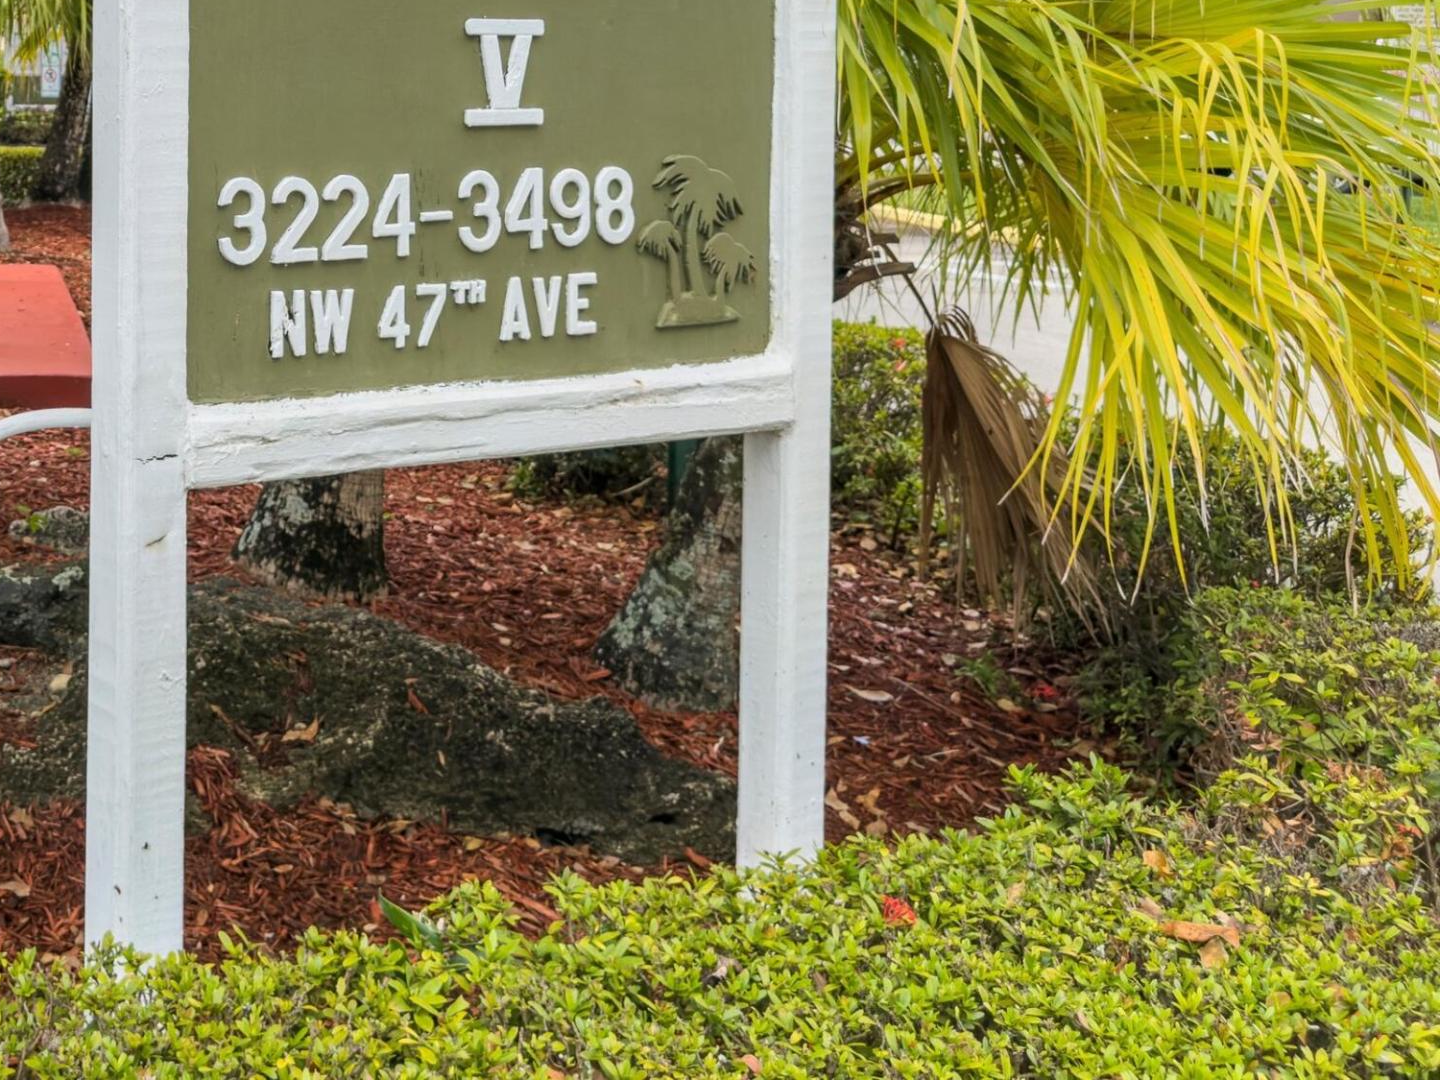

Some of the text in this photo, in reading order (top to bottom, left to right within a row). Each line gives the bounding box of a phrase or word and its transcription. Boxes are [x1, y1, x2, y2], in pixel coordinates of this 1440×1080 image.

[464, 18, 545, 127] V
[217, 166, 636, 266] 3224-3498
[269, 288, 354, 358] NW
[500, 272, 598, 341] AVE
